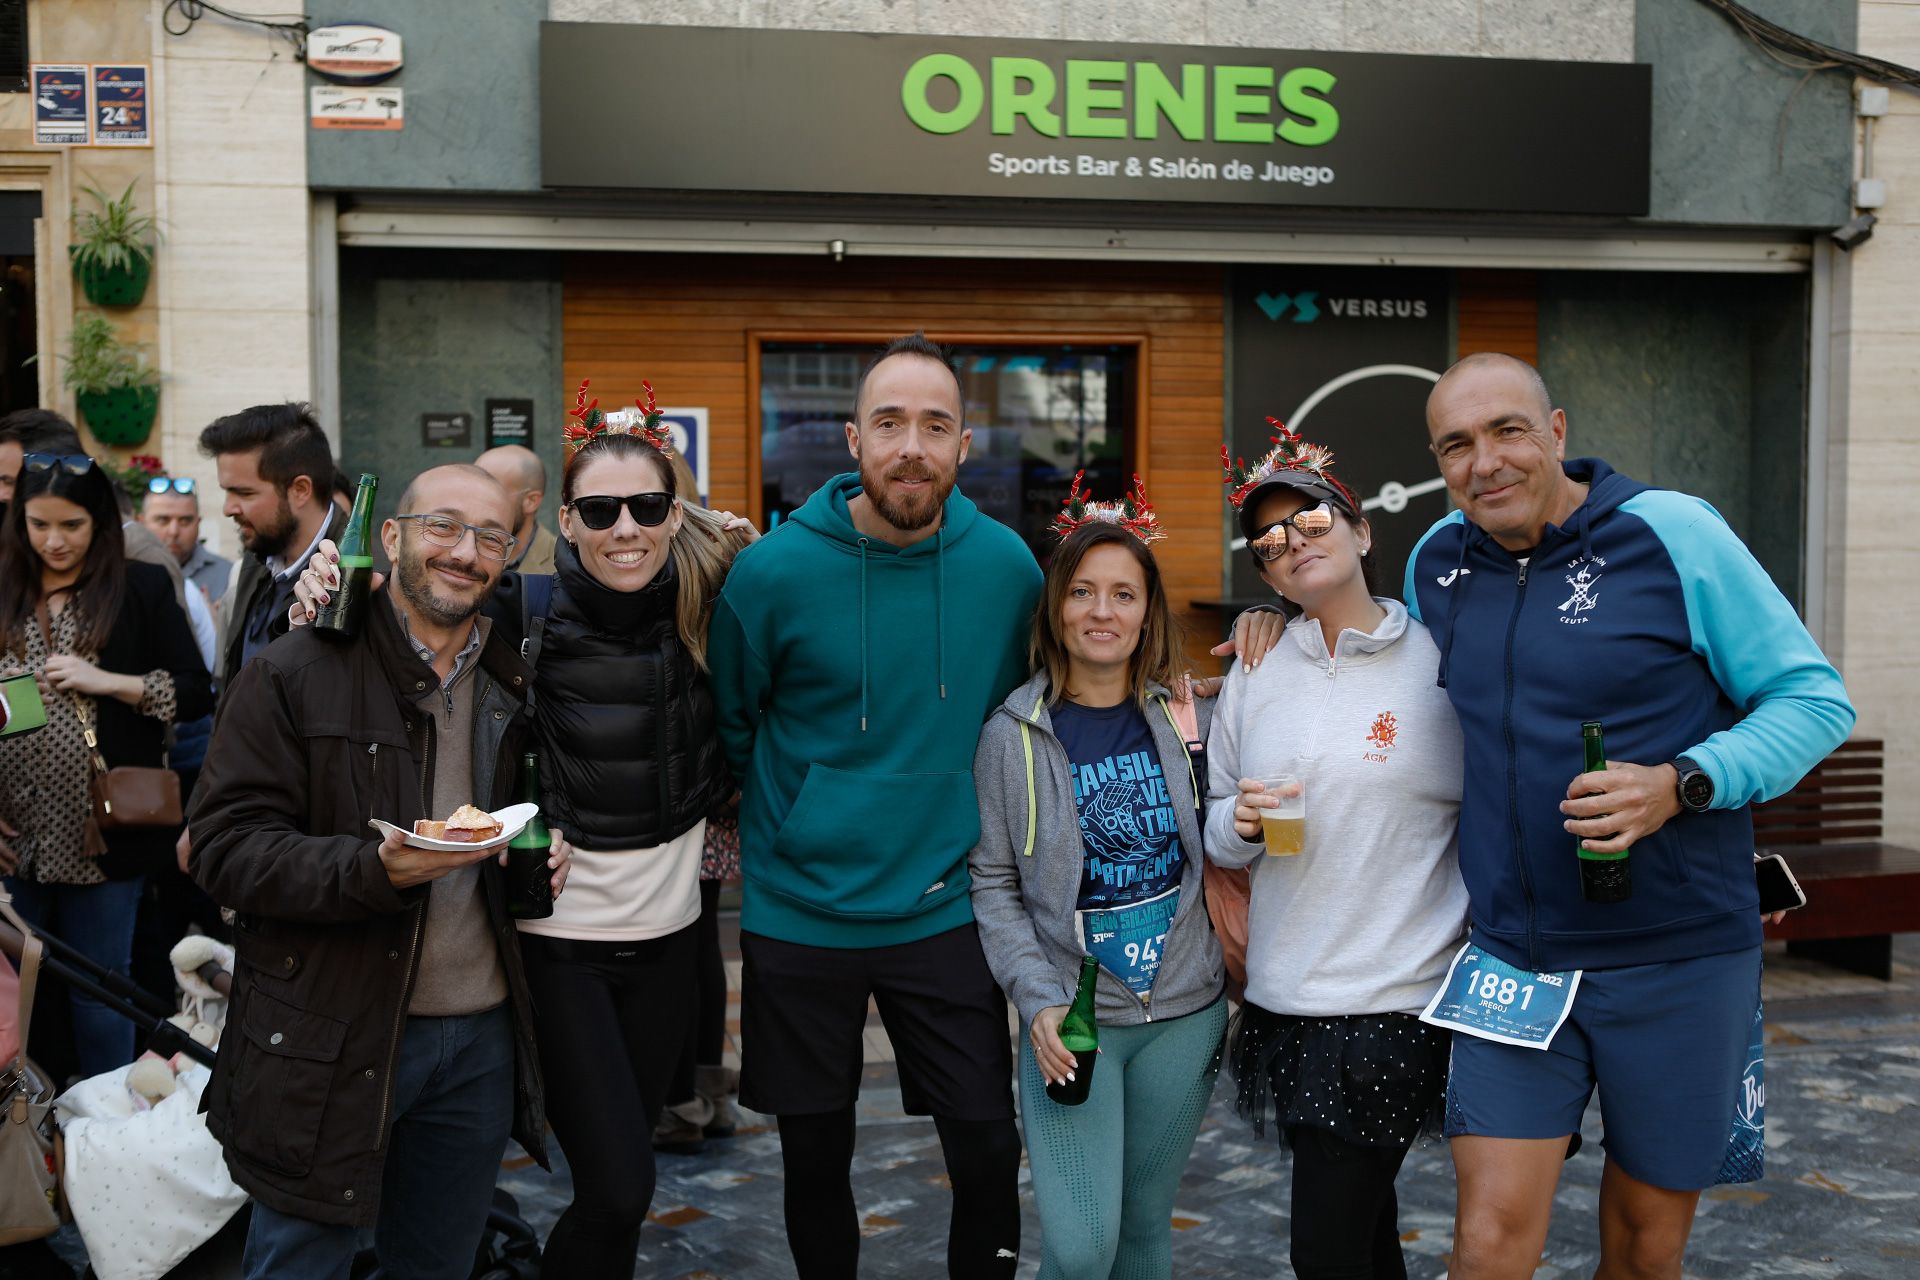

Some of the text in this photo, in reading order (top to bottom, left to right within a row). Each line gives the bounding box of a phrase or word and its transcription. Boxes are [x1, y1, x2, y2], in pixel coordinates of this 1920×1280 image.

[902, 53, 1340, 147] ORENES
[988, 152, 1334, 187] Sports Bar & Salón de Juego
[1328, 298, 1428, 318] VERSUS
[1568, 555, 1607, 568] LA LIÓN
[1560, 616, 1589, 624] CEUTA
[1363, 752, 1388, 763] AGM
[1536, 972, 1563, 988] 2022
[1467, 969, 1535, 1011] 1881
[1478, 999, 1508, 1013] JREGOJ
